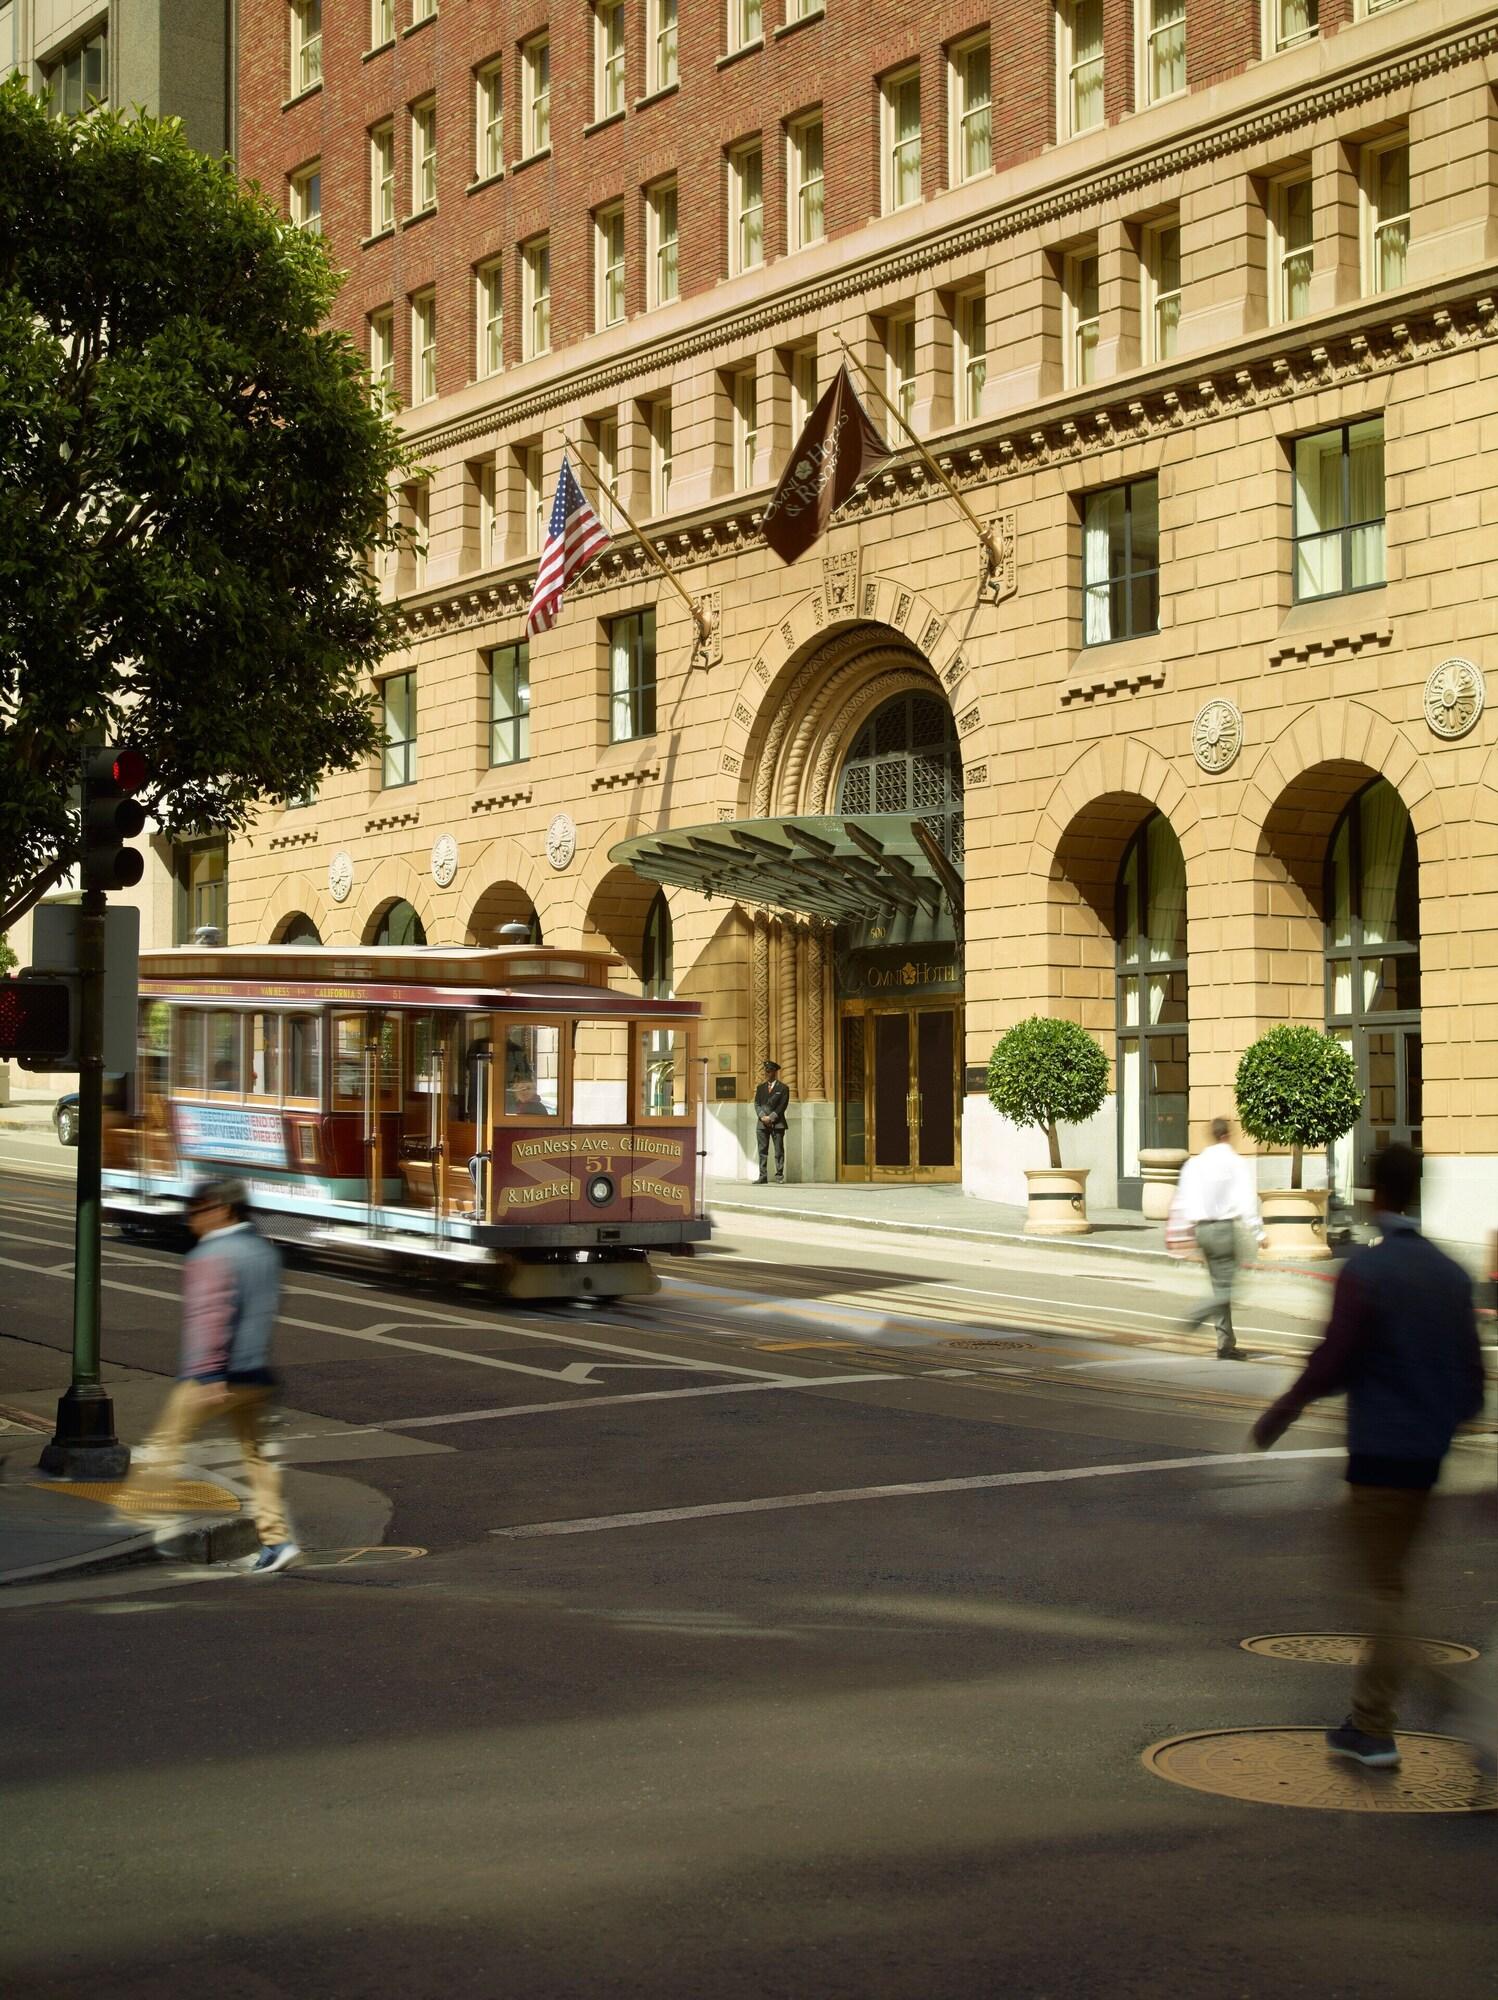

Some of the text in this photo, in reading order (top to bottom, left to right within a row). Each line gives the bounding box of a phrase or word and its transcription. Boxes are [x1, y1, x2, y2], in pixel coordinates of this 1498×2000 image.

[516, 1142, 541, 1158] Van
[543, 1137, 577, 1155] Ness
[620, 1137, 682, 1157] California
[585, 1156, 615, 1173] 51
[508, 1182, 574, 1203] & Market
[632, 1178, 683, 1200] Streets
